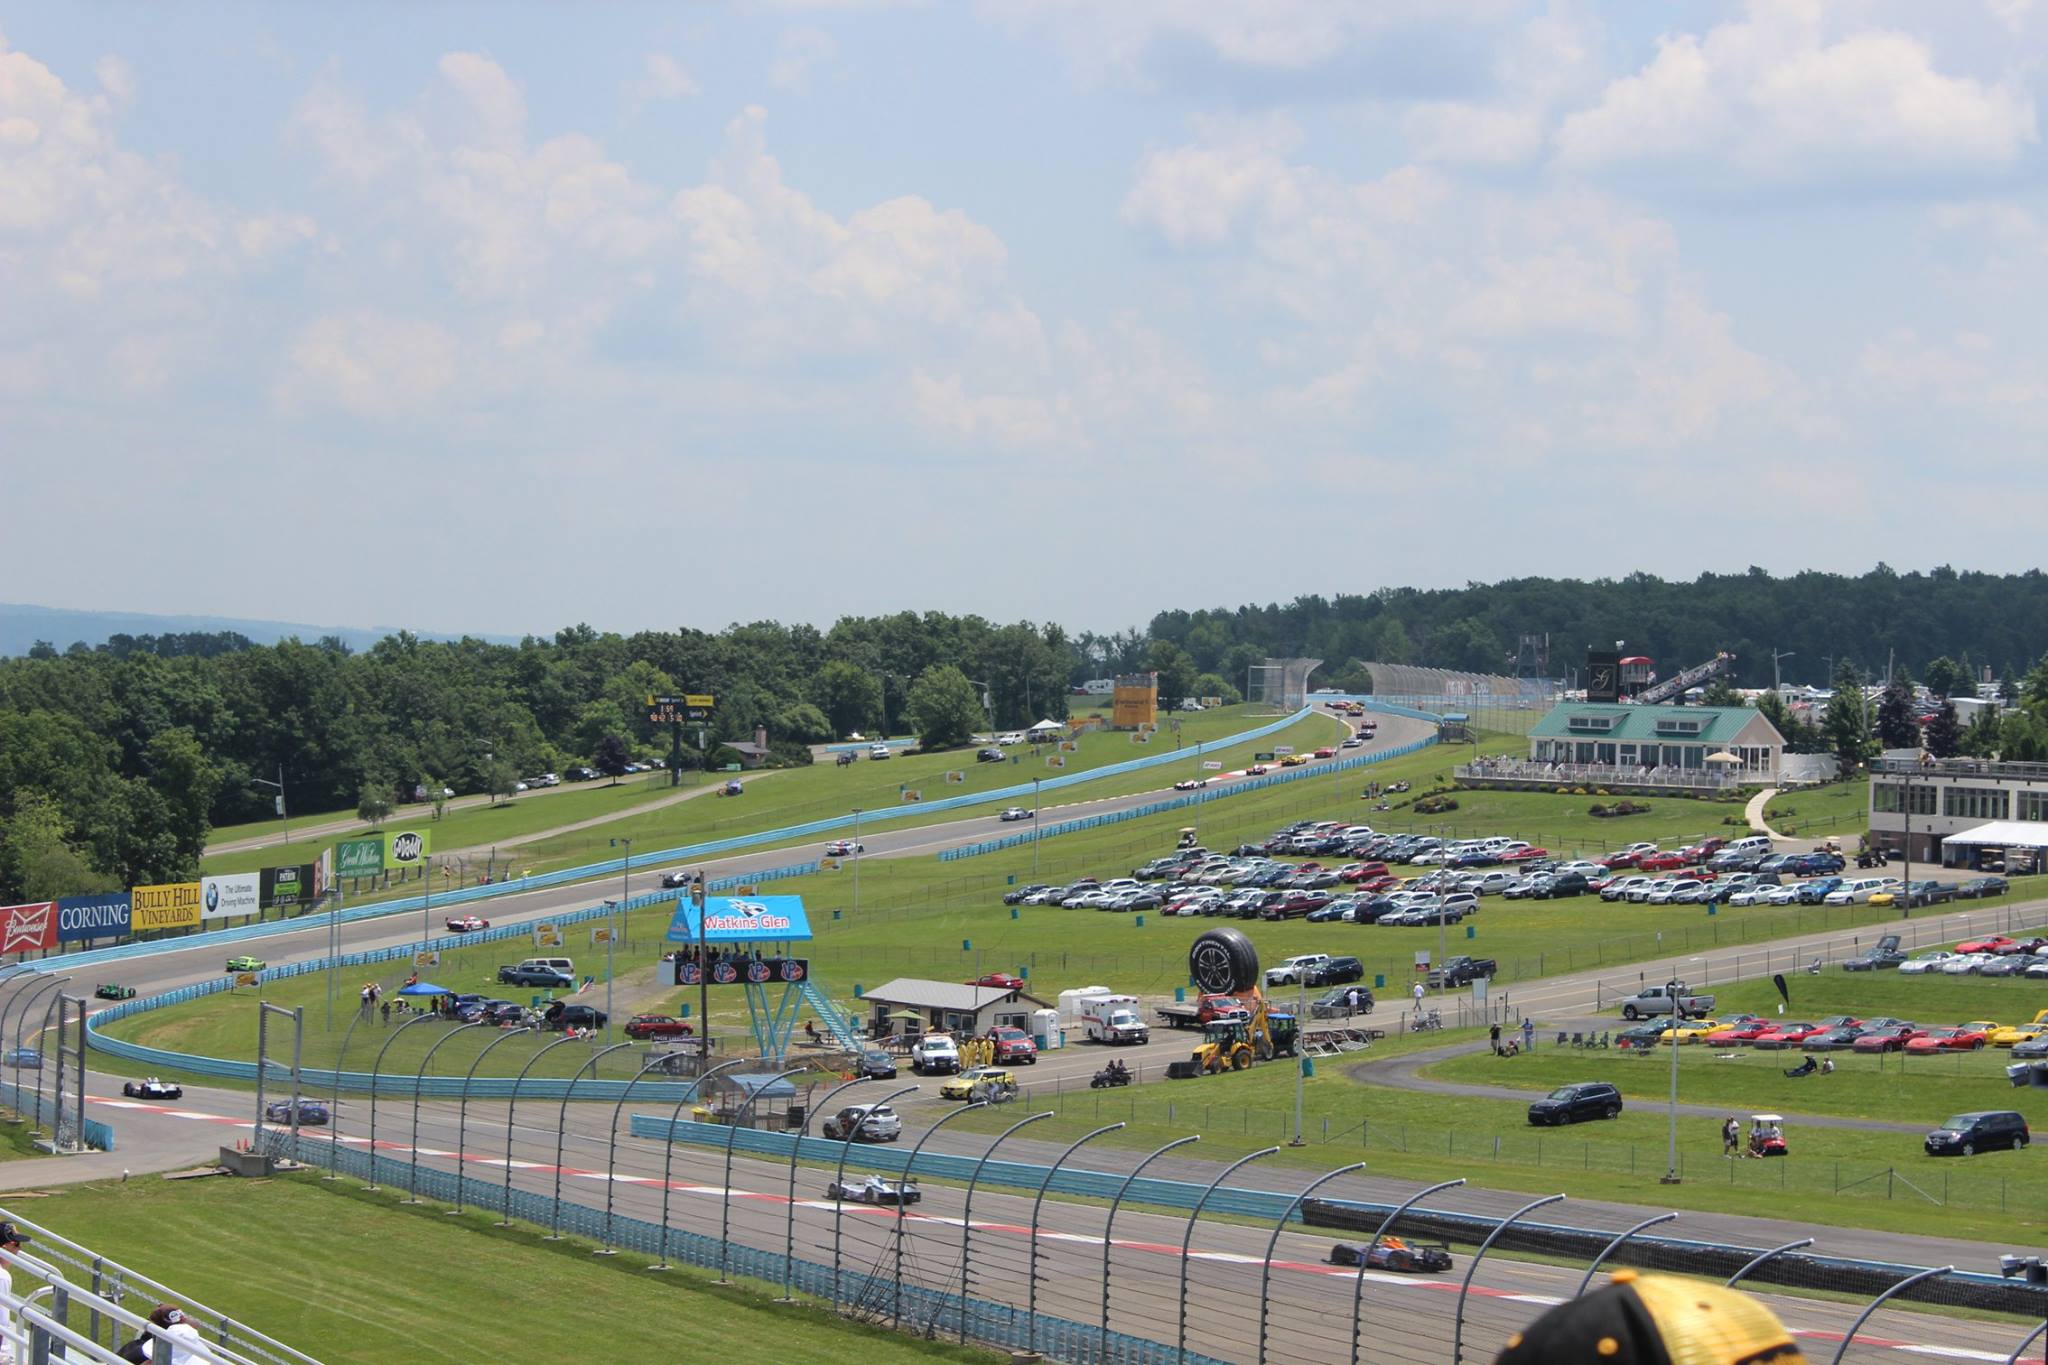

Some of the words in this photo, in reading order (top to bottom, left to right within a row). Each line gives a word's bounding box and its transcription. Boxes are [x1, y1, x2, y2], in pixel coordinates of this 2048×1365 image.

[134, 891, 170, 910] BULLY
[173, 888, 200, 906] HILL
[60, 903, 129, 930] CORNING
[140, 907, 194, 925] VINEYARDS
[704, 915, 758, 930] Watkins
[760, 915, 789, 929] Glen
[5, 919, 48, 937] Budweiser
